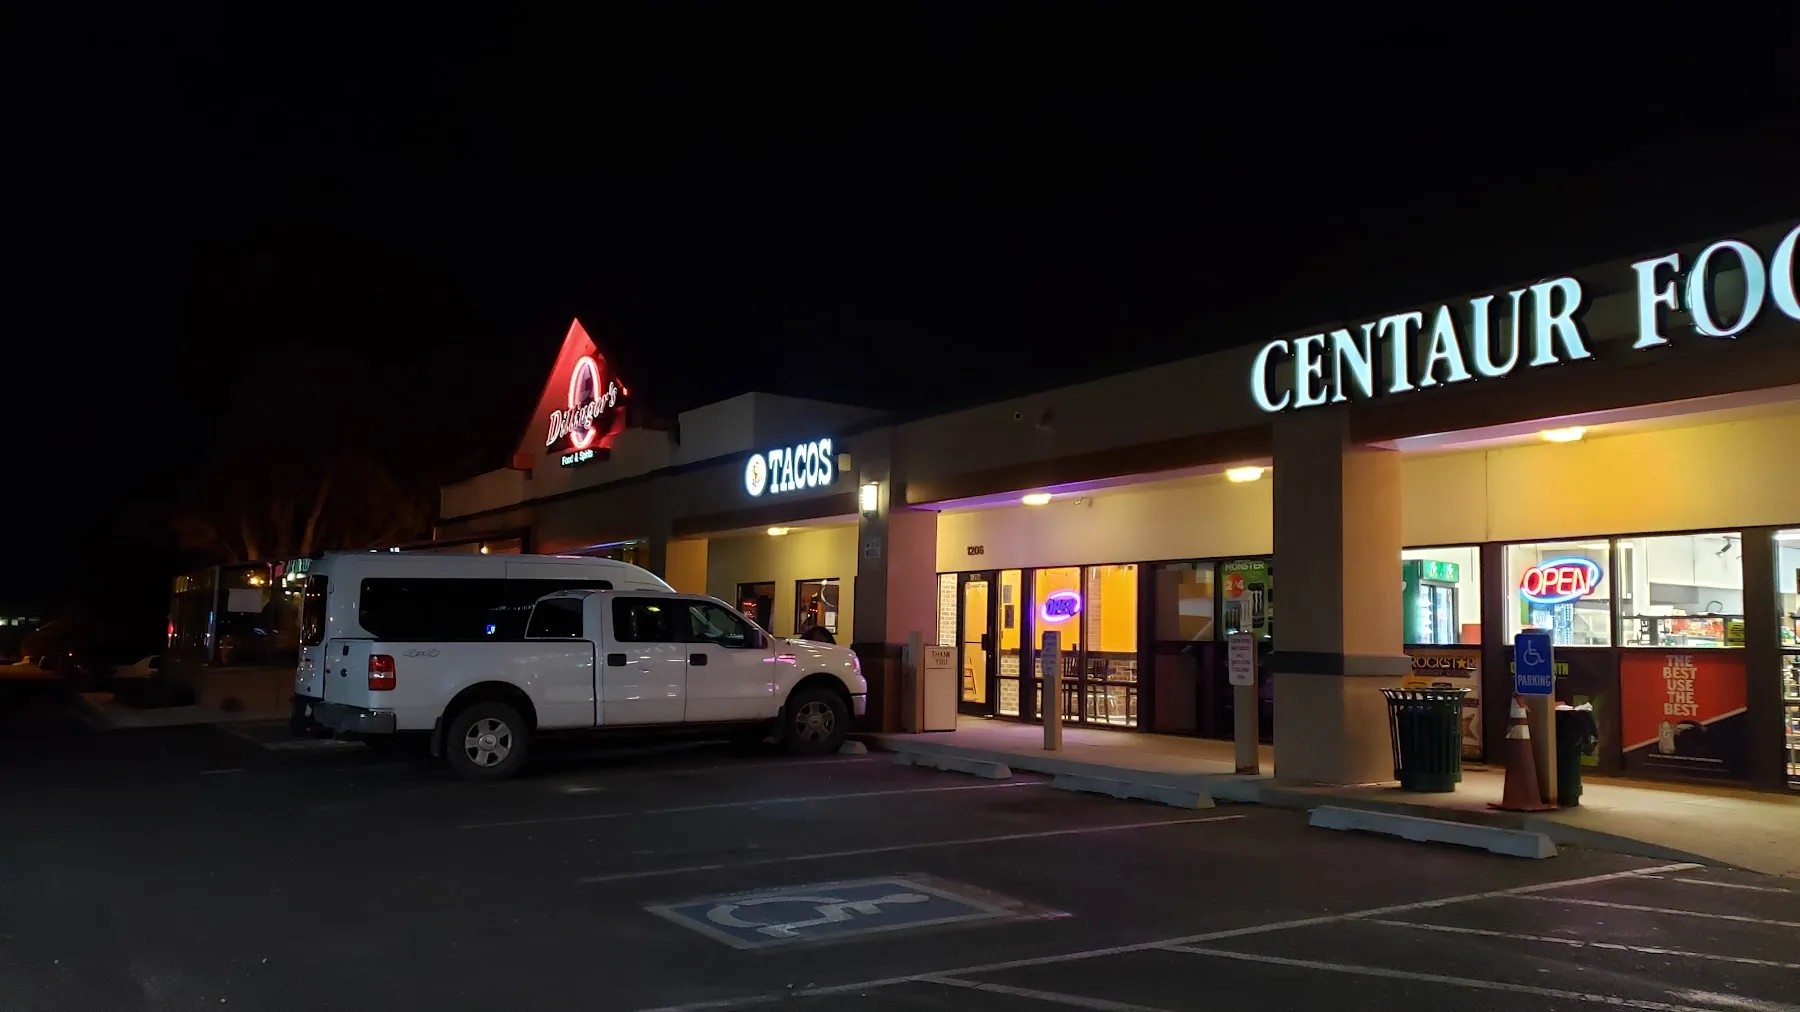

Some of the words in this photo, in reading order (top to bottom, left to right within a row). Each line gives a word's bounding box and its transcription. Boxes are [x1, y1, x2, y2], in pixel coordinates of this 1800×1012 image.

[1251, 275, 1591, 412] CENTAUR
[545, 381, 618, 447] Dillinger's
[561, 454, 574, 466] Food
[768, 437, 832, 493] TACOS
[1224, 561, 1265, 572] MONSTER
[1522, 566, 1593, 596] OPEN
[931, 650, 951, 658] THANK
[935, 658, 949, 666] YOU
[1666, 655, 1693, 667] THE
[1662, 667, 1697, 679] BEST
[1517, 674, 1551, 687] PARKING
[1667, 680, 1694, 691] USE
[1667, 691, 1694, 703] THE
[1663, 703, 1699, 716] BEST
